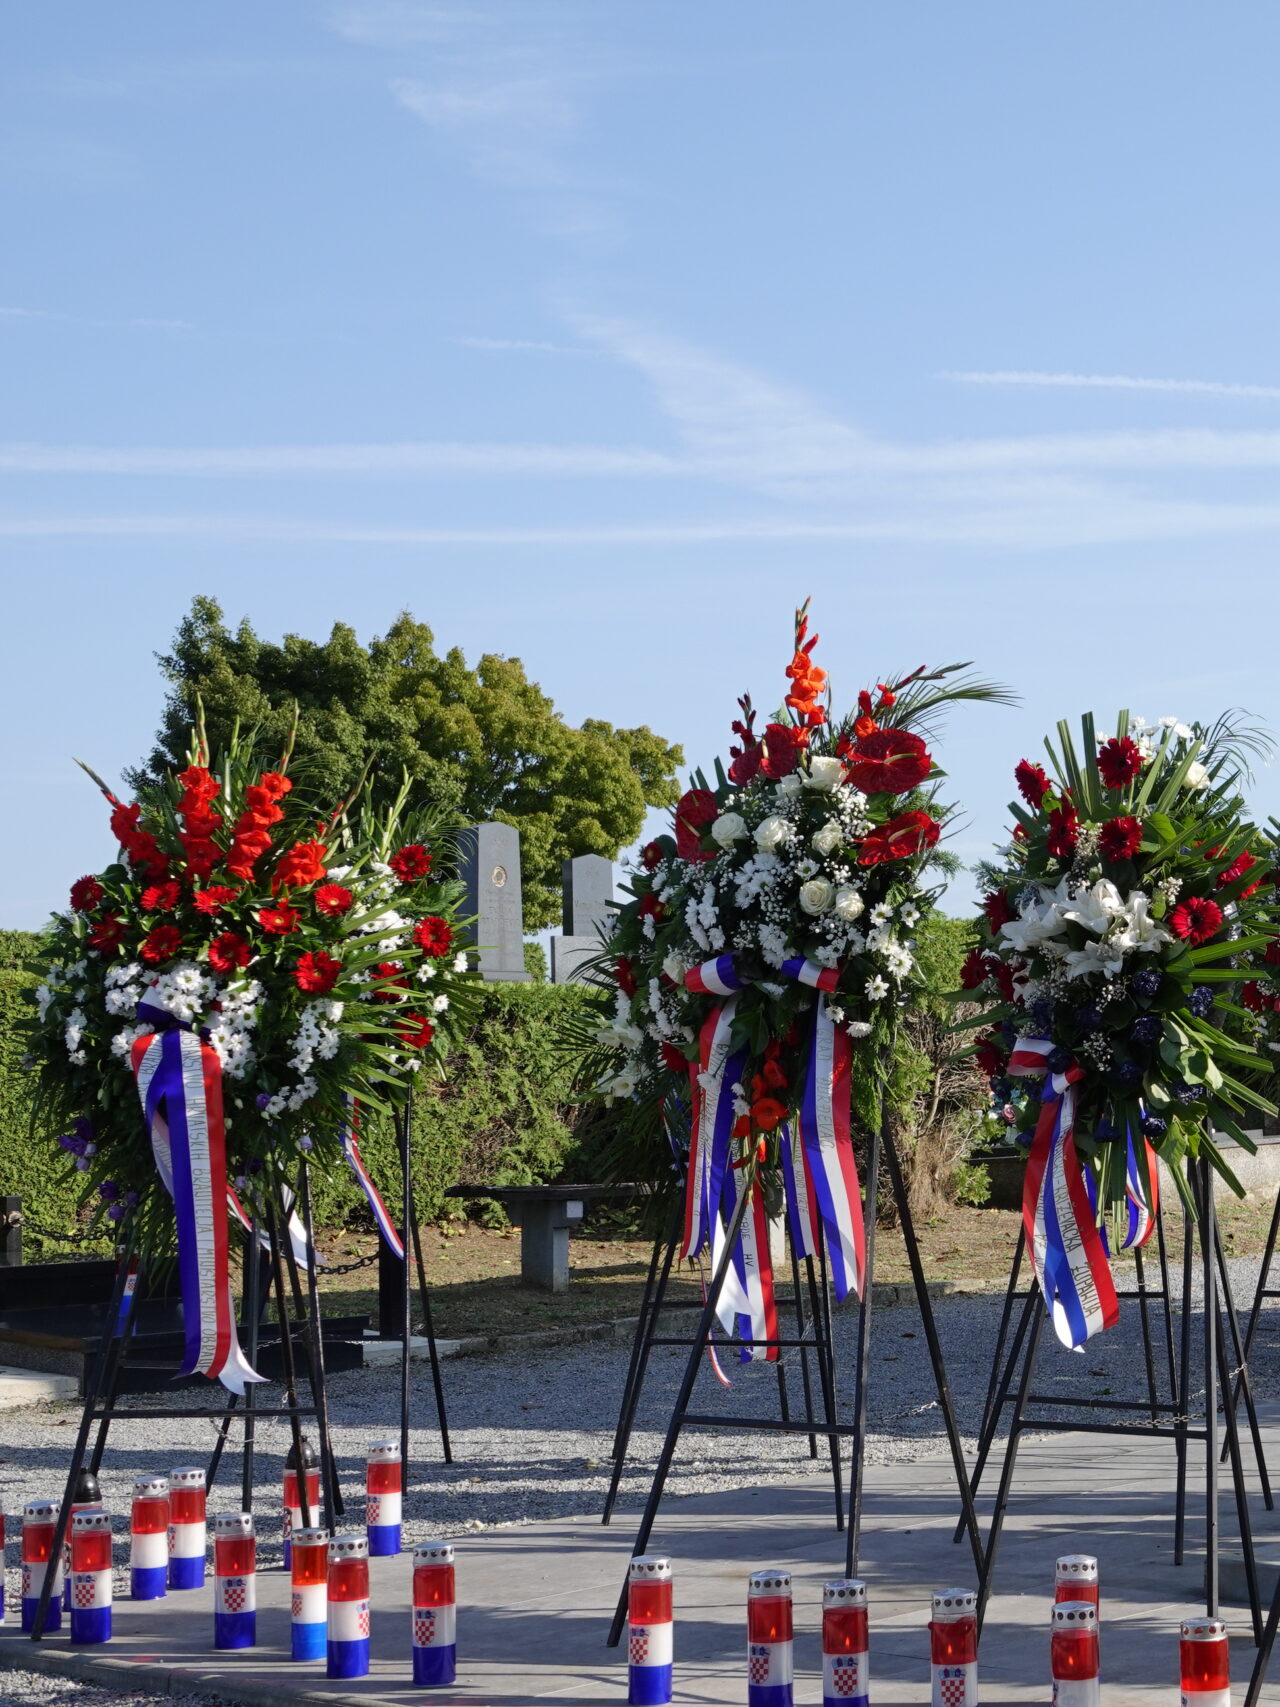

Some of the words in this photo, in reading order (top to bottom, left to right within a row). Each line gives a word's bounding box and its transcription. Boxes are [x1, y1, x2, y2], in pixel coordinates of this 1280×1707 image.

[816, 1027, 832, 1060] GRAD
[187, 1097, 208, 1160] HRVATSKIH
[192, 1167, 212, 1233] BRANITELJA
[197, 1247, 215, 1323] MINISTARSTVO
[744, 1253, 754, 1266] HV
[1070, 1262, 1100, 1316] ŽUPANIJA
